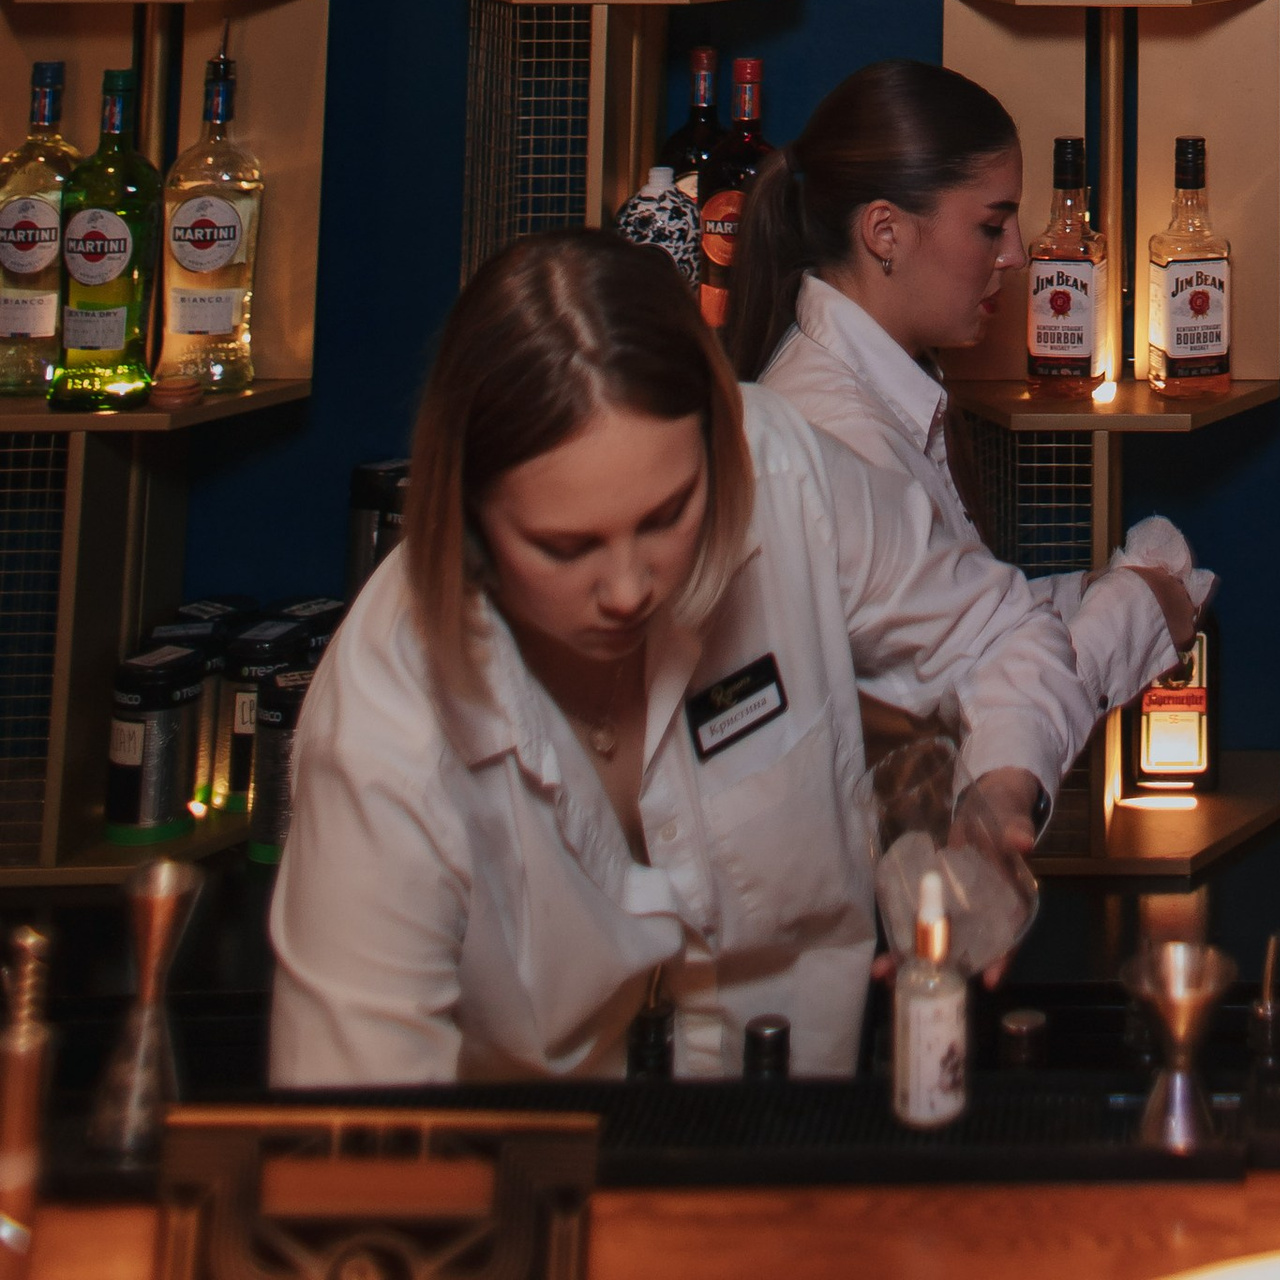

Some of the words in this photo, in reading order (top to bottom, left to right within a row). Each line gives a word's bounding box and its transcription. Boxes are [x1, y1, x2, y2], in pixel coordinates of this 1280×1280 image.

[0, 228, 56, 243] MARTINI
[174, 227, 235, 241] MARTINI
[67, 239, 126, 253] MARTINI
[1033, 275, 1055, 296] JIM
[1056, 271, 1088, 296] BEAM
[1171, 276, 1194, 298] JIM
[1195, 271, 1224, 294] BEAM
[180, 296, 224, 304] BIANCO
[99, 310, 117, 318] DRY
[1036, 332, 1083, 345] BOURBON
[1176, 331, 1221, 345] BOURBON
[709, 696, 767, 737] Кристина
